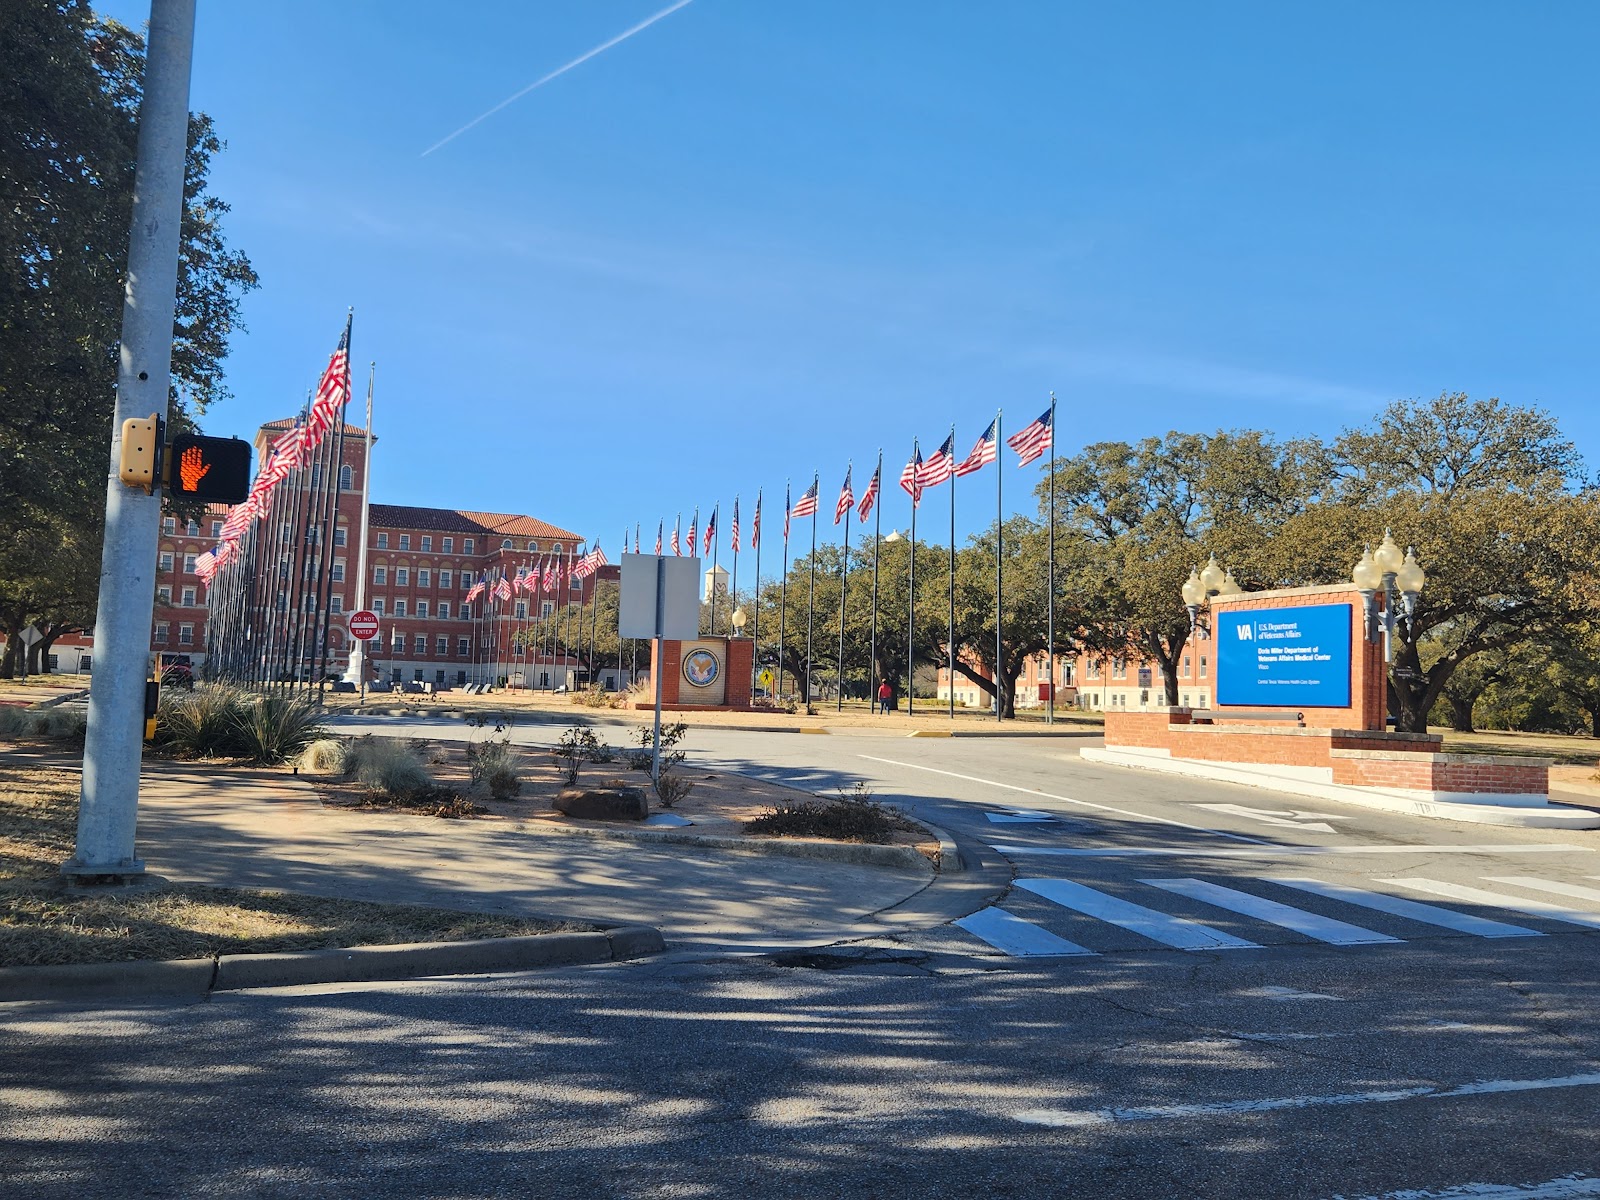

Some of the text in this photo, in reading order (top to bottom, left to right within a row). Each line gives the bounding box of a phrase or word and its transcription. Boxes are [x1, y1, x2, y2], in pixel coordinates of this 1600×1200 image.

[1236, 624, 1252, 640] VA
[1268, 622, 1297, 632] Department
[1285, 630, 1302, 638] Affairs
